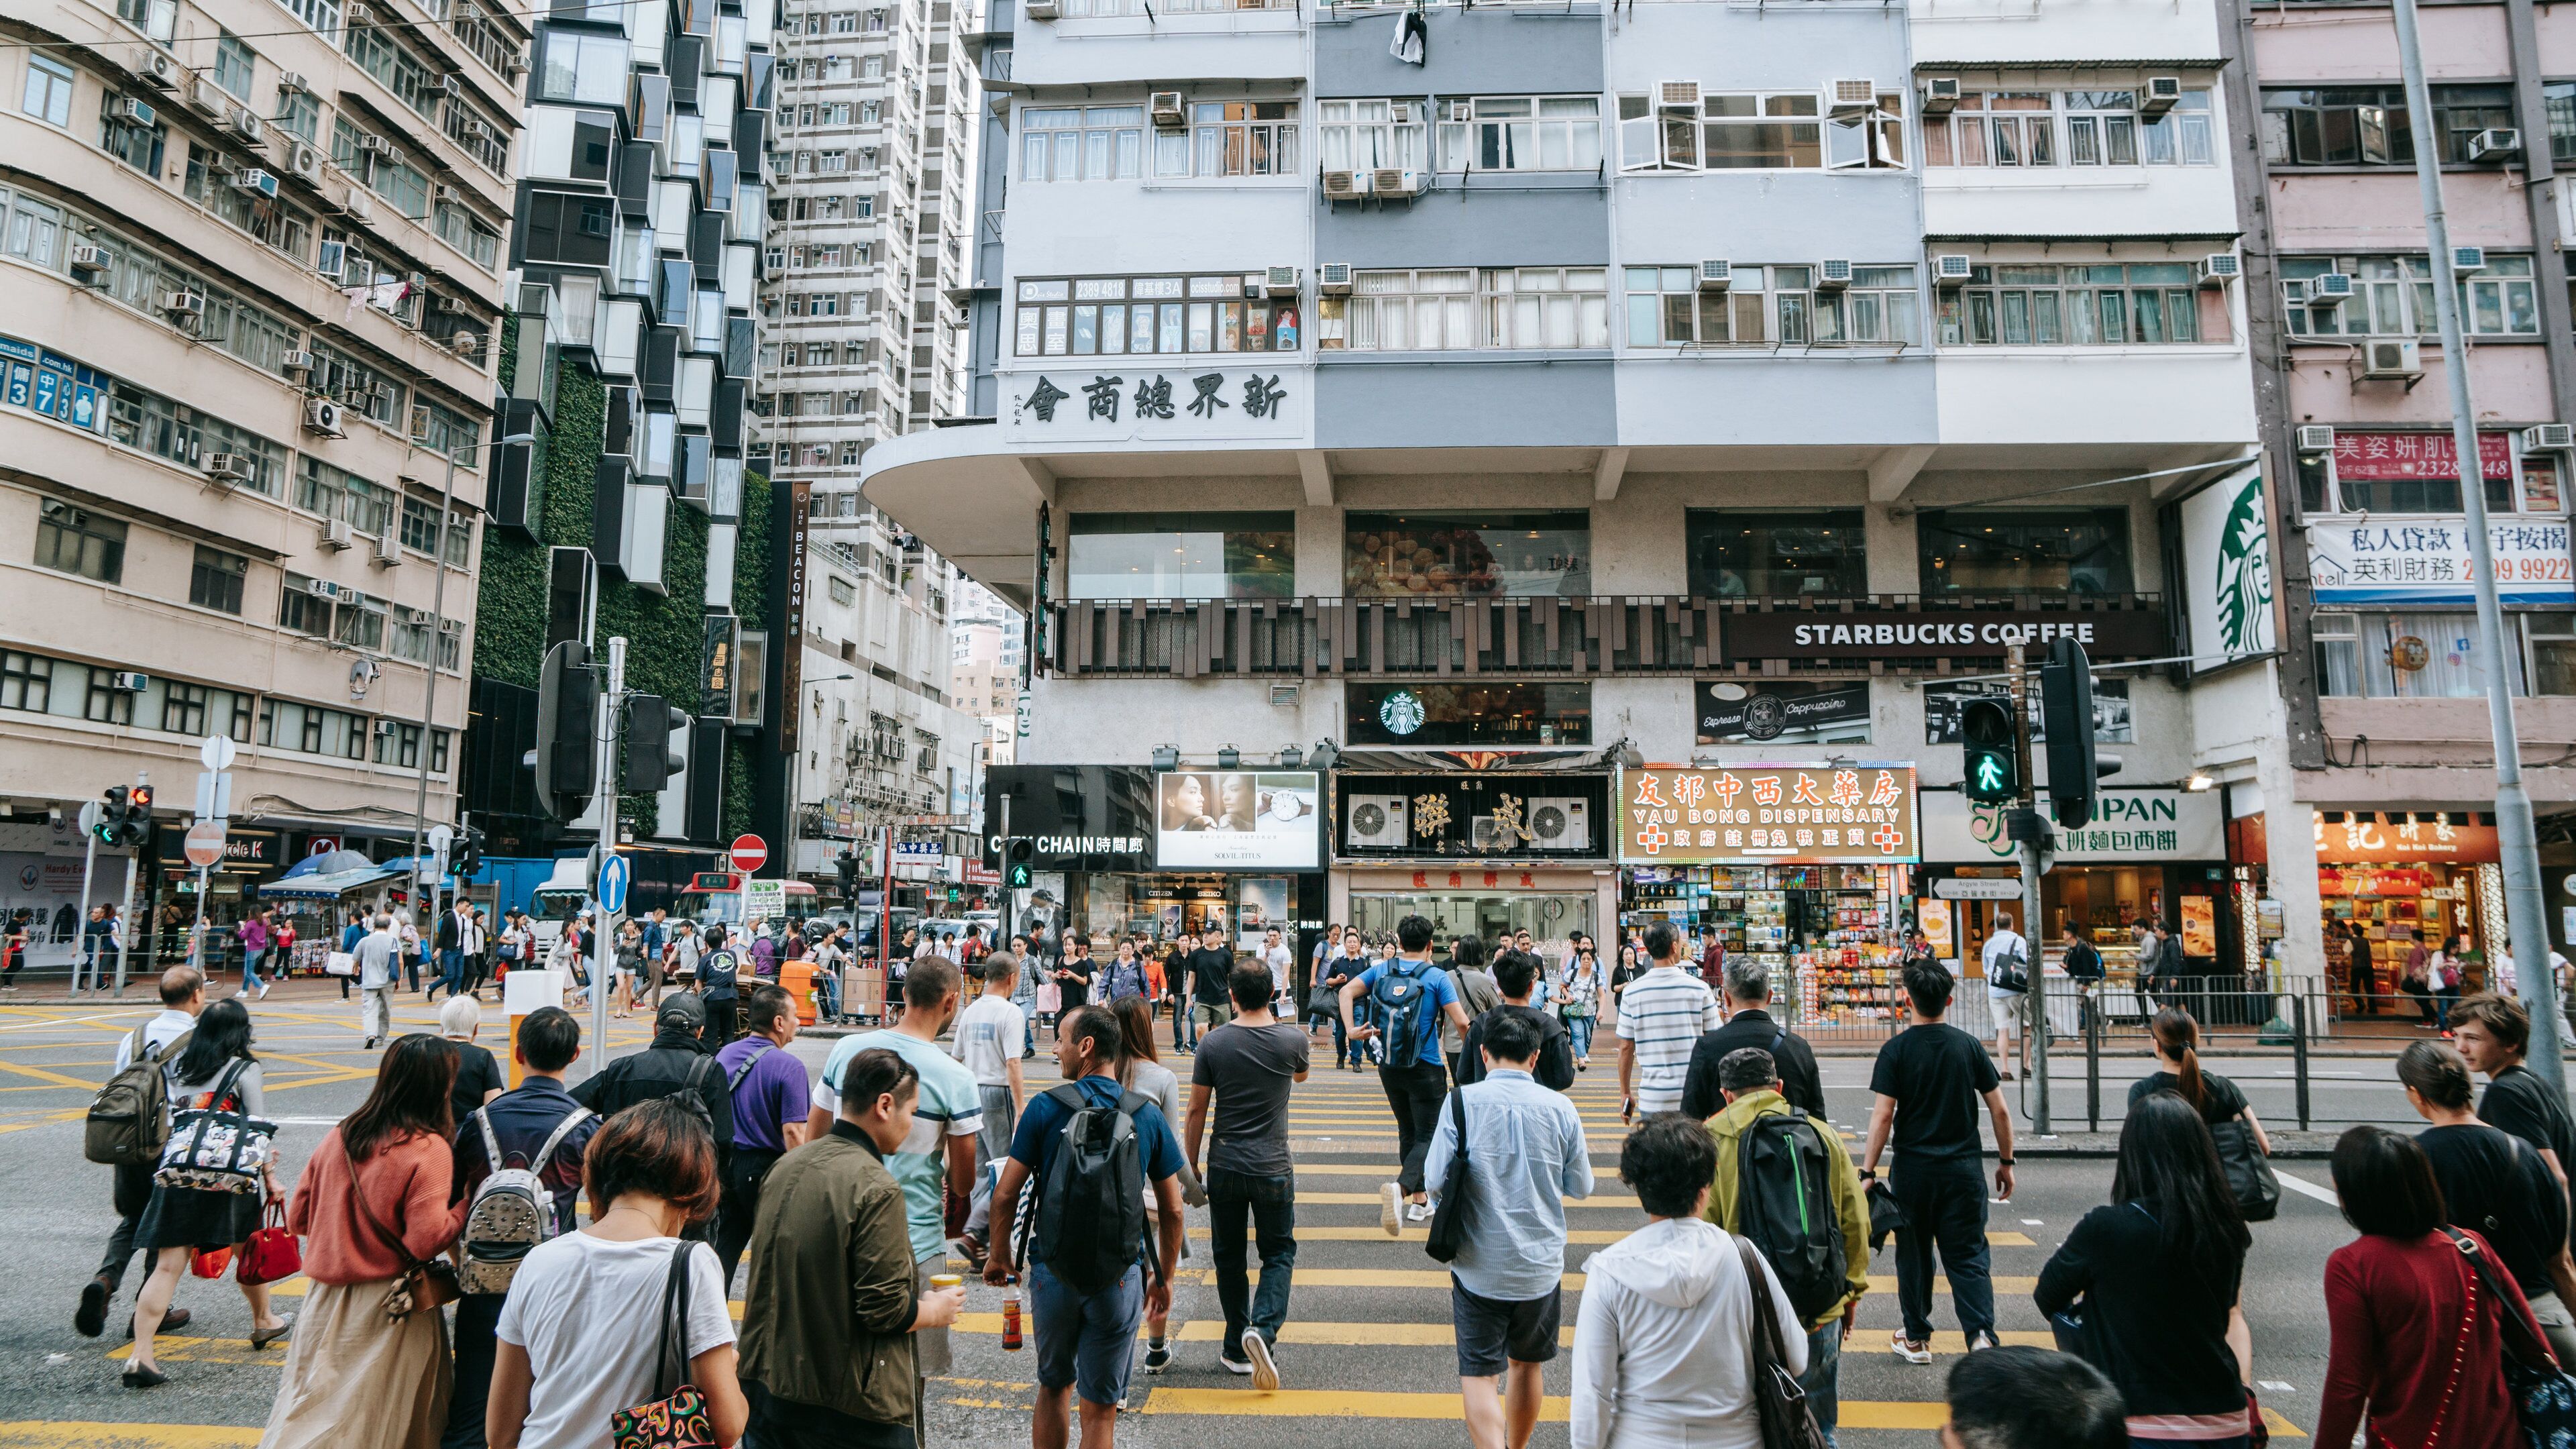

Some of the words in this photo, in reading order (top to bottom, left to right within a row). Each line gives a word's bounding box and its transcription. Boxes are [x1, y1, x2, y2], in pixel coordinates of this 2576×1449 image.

[1077, 282, 1099, 298] 2389
[1102, 282, 1124, 297] 4818
[1134, 281, 1181, 296] 偉基樓3A
[1191, 280, 1240, 294] ocisstudio.com
[1018, 311, 1038, 352] 奧思
[1046, 311, 1067, 351] 畫室
[42, 358, 72, 374] .com.hk
[1024, 372, 1287, 423] 新界總商會
[2337, 435, 2449, 459] 美姿妍肌
[2350, 527, 2451, 552] 私人貸款
[792, 531, 804, 606] BEACON
[2353, 557, 2455, 581] 英利財務
[2520, 557, 2572, 580] 9922
[1794, 623, 1976, 645] STARBUCKS
[1786, 698, 1846, 715] Cappuccino
[1704, 714, 1741, 728] Espresso
[1746, 721, 1762, 736] COFFEE
[1764, 727, 1776, 736] AND
[1633, 770, 1902, 808] 友邦中西大藥房
[1633, 809, 1678, 824] YAU
[1688, 809, 1750, 824] BONG
[1760, 808, 1900, 824] DISPENSARY
[1037, 836, 1093, 853] CHAIN
[1096, 836, 1143, 853] 時間廊
[1673, 828, 1865, 847] 政府註冊免稅正貨
[223, 840, 249, 857] rcle
[252, 841, 264, 858] K
[45, 863, 71, 875] Hardy
